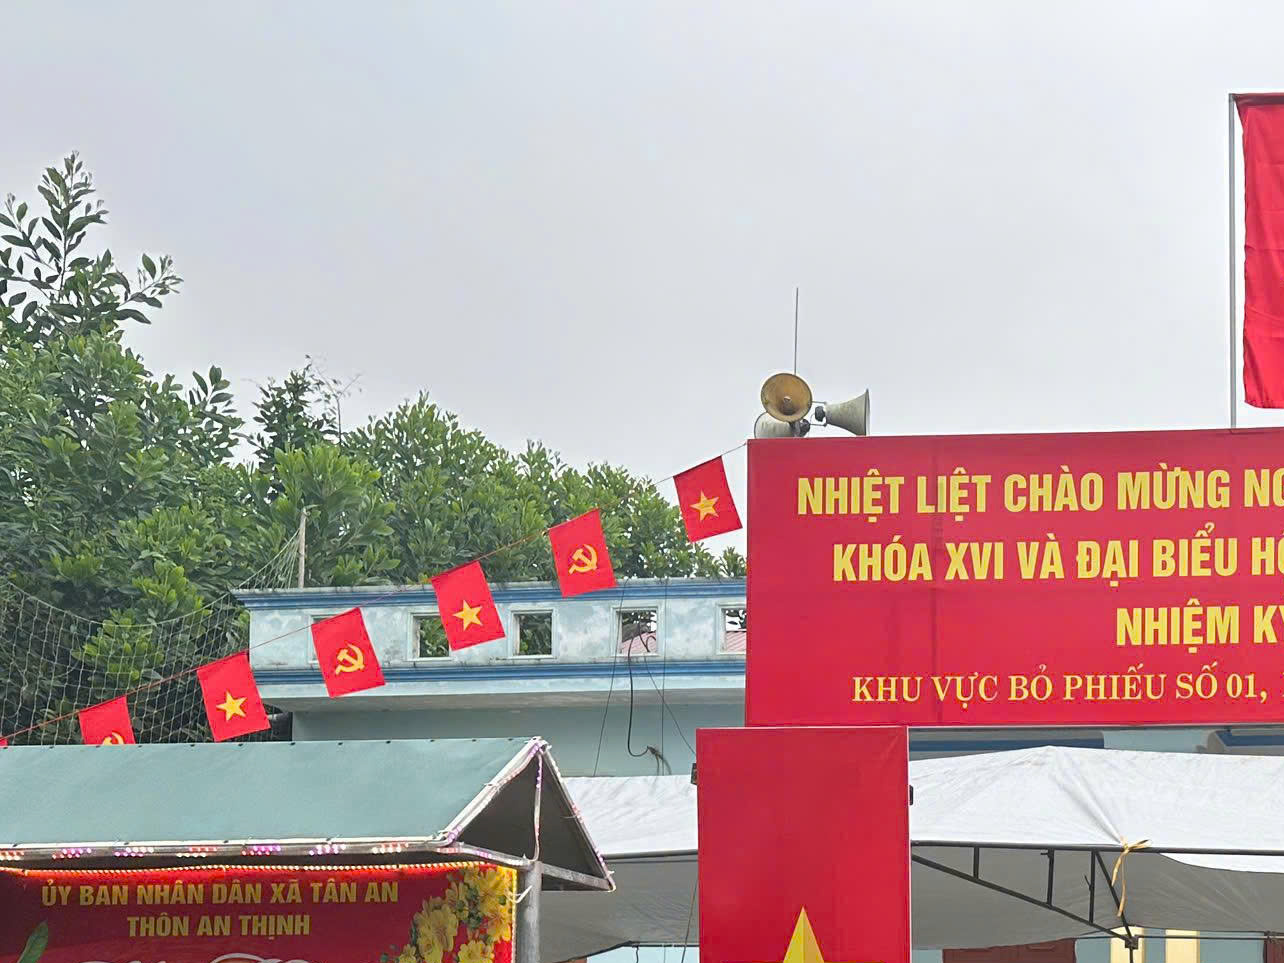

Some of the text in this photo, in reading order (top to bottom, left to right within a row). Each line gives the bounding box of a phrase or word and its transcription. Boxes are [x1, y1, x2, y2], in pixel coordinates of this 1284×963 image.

[797, 468, 905, 523] NHIỆT
[916, 466, 992, 522] LIỆT
[1004, 465, 1104, 513] CHÀO
[1117, 463, 1230, 511] MỪNG
[833, 535, 933, 582] KHÓA
[944, 541, 1004, 581] XVI
[1016, 532, 1065, 580] VÀ
[1075, 539, 1139, 587] ĐẠI
[1153, 521, 1238, 577] BIỂU
[1116, 597, 1240, 654] NHIỆM
[852, 676, 923, 702] KHU
[930, 671, 1000, 710] VỰC
[1007, 663, 1054, 702] BỎ
[1063, 663, 1167, 700] PHIẾU
[1175, 661, 1218, 699] SỐ
[1226, 673, 1267, 703] 01,
[40, 877, 398, 907] ỦY BAN NHÂN DÂN XÃ TÂN AN
[125, 910, 312, 942] THÔN AN THỊNH
